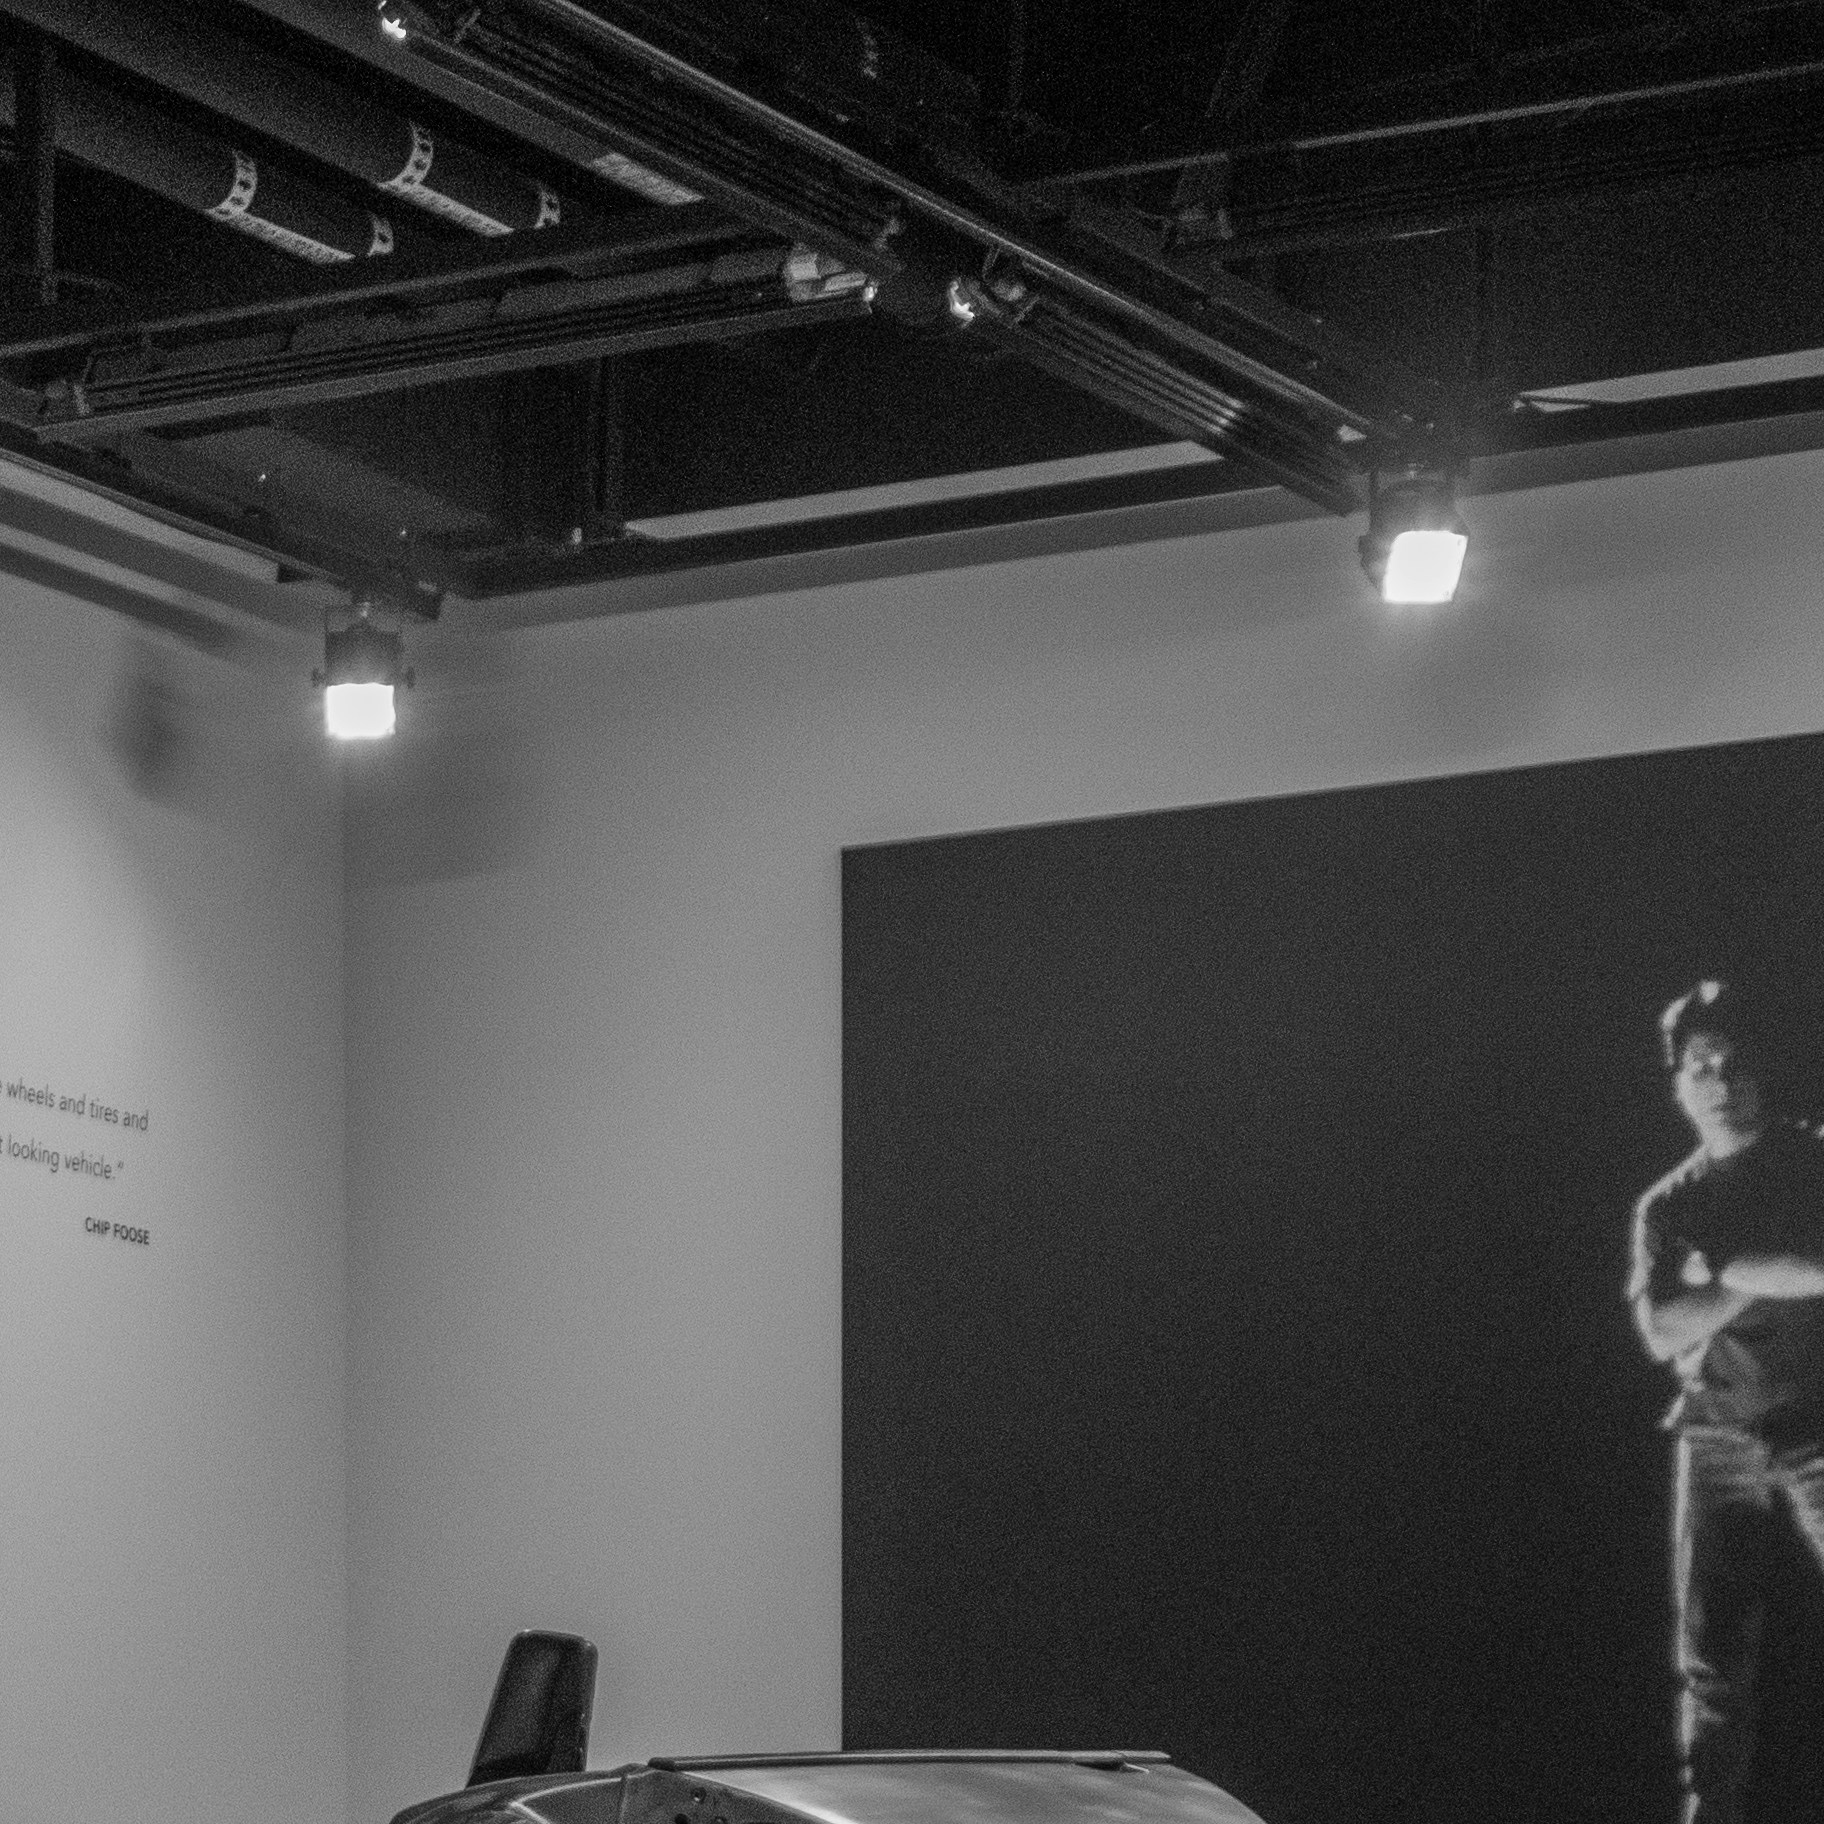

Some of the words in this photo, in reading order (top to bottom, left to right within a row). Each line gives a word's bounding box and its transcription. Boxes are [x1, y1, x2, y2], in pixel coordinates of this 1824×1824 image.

[7, 1080, 54, 1108] wheels
[59, 1095, 85, 1116] and
[90, 1101, 118, 1124] tires
[122, 1111, 149, 1132] and
[7, 1136, 60, 1174] looking
[84, 1216, 111, 1236] CHIP
[113, 1223, 150, 1246] FOOSE
